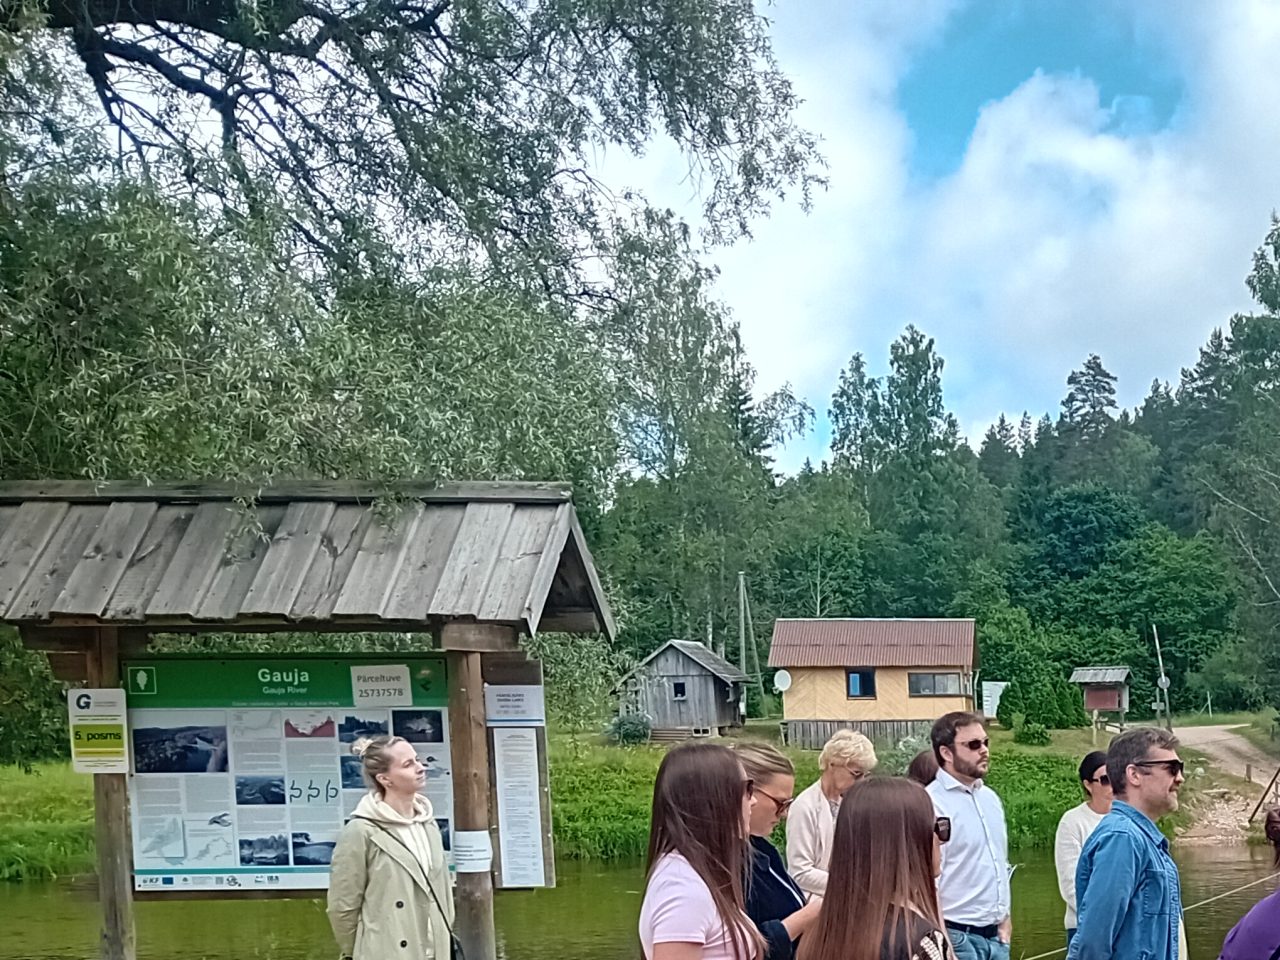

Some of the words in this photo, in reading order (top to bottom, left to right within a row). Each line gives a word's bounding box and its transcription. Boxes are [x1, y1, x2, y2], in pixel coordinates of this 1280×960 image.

[258, 668, 310, 686] Gauja
[262, 686, 286, 695] Gauja
[287, 686, 308, 694] River
[358, 688, 404, 698] 25737578
[76, 693, 92, 709] G
[86, 732, 122, 742] posms
